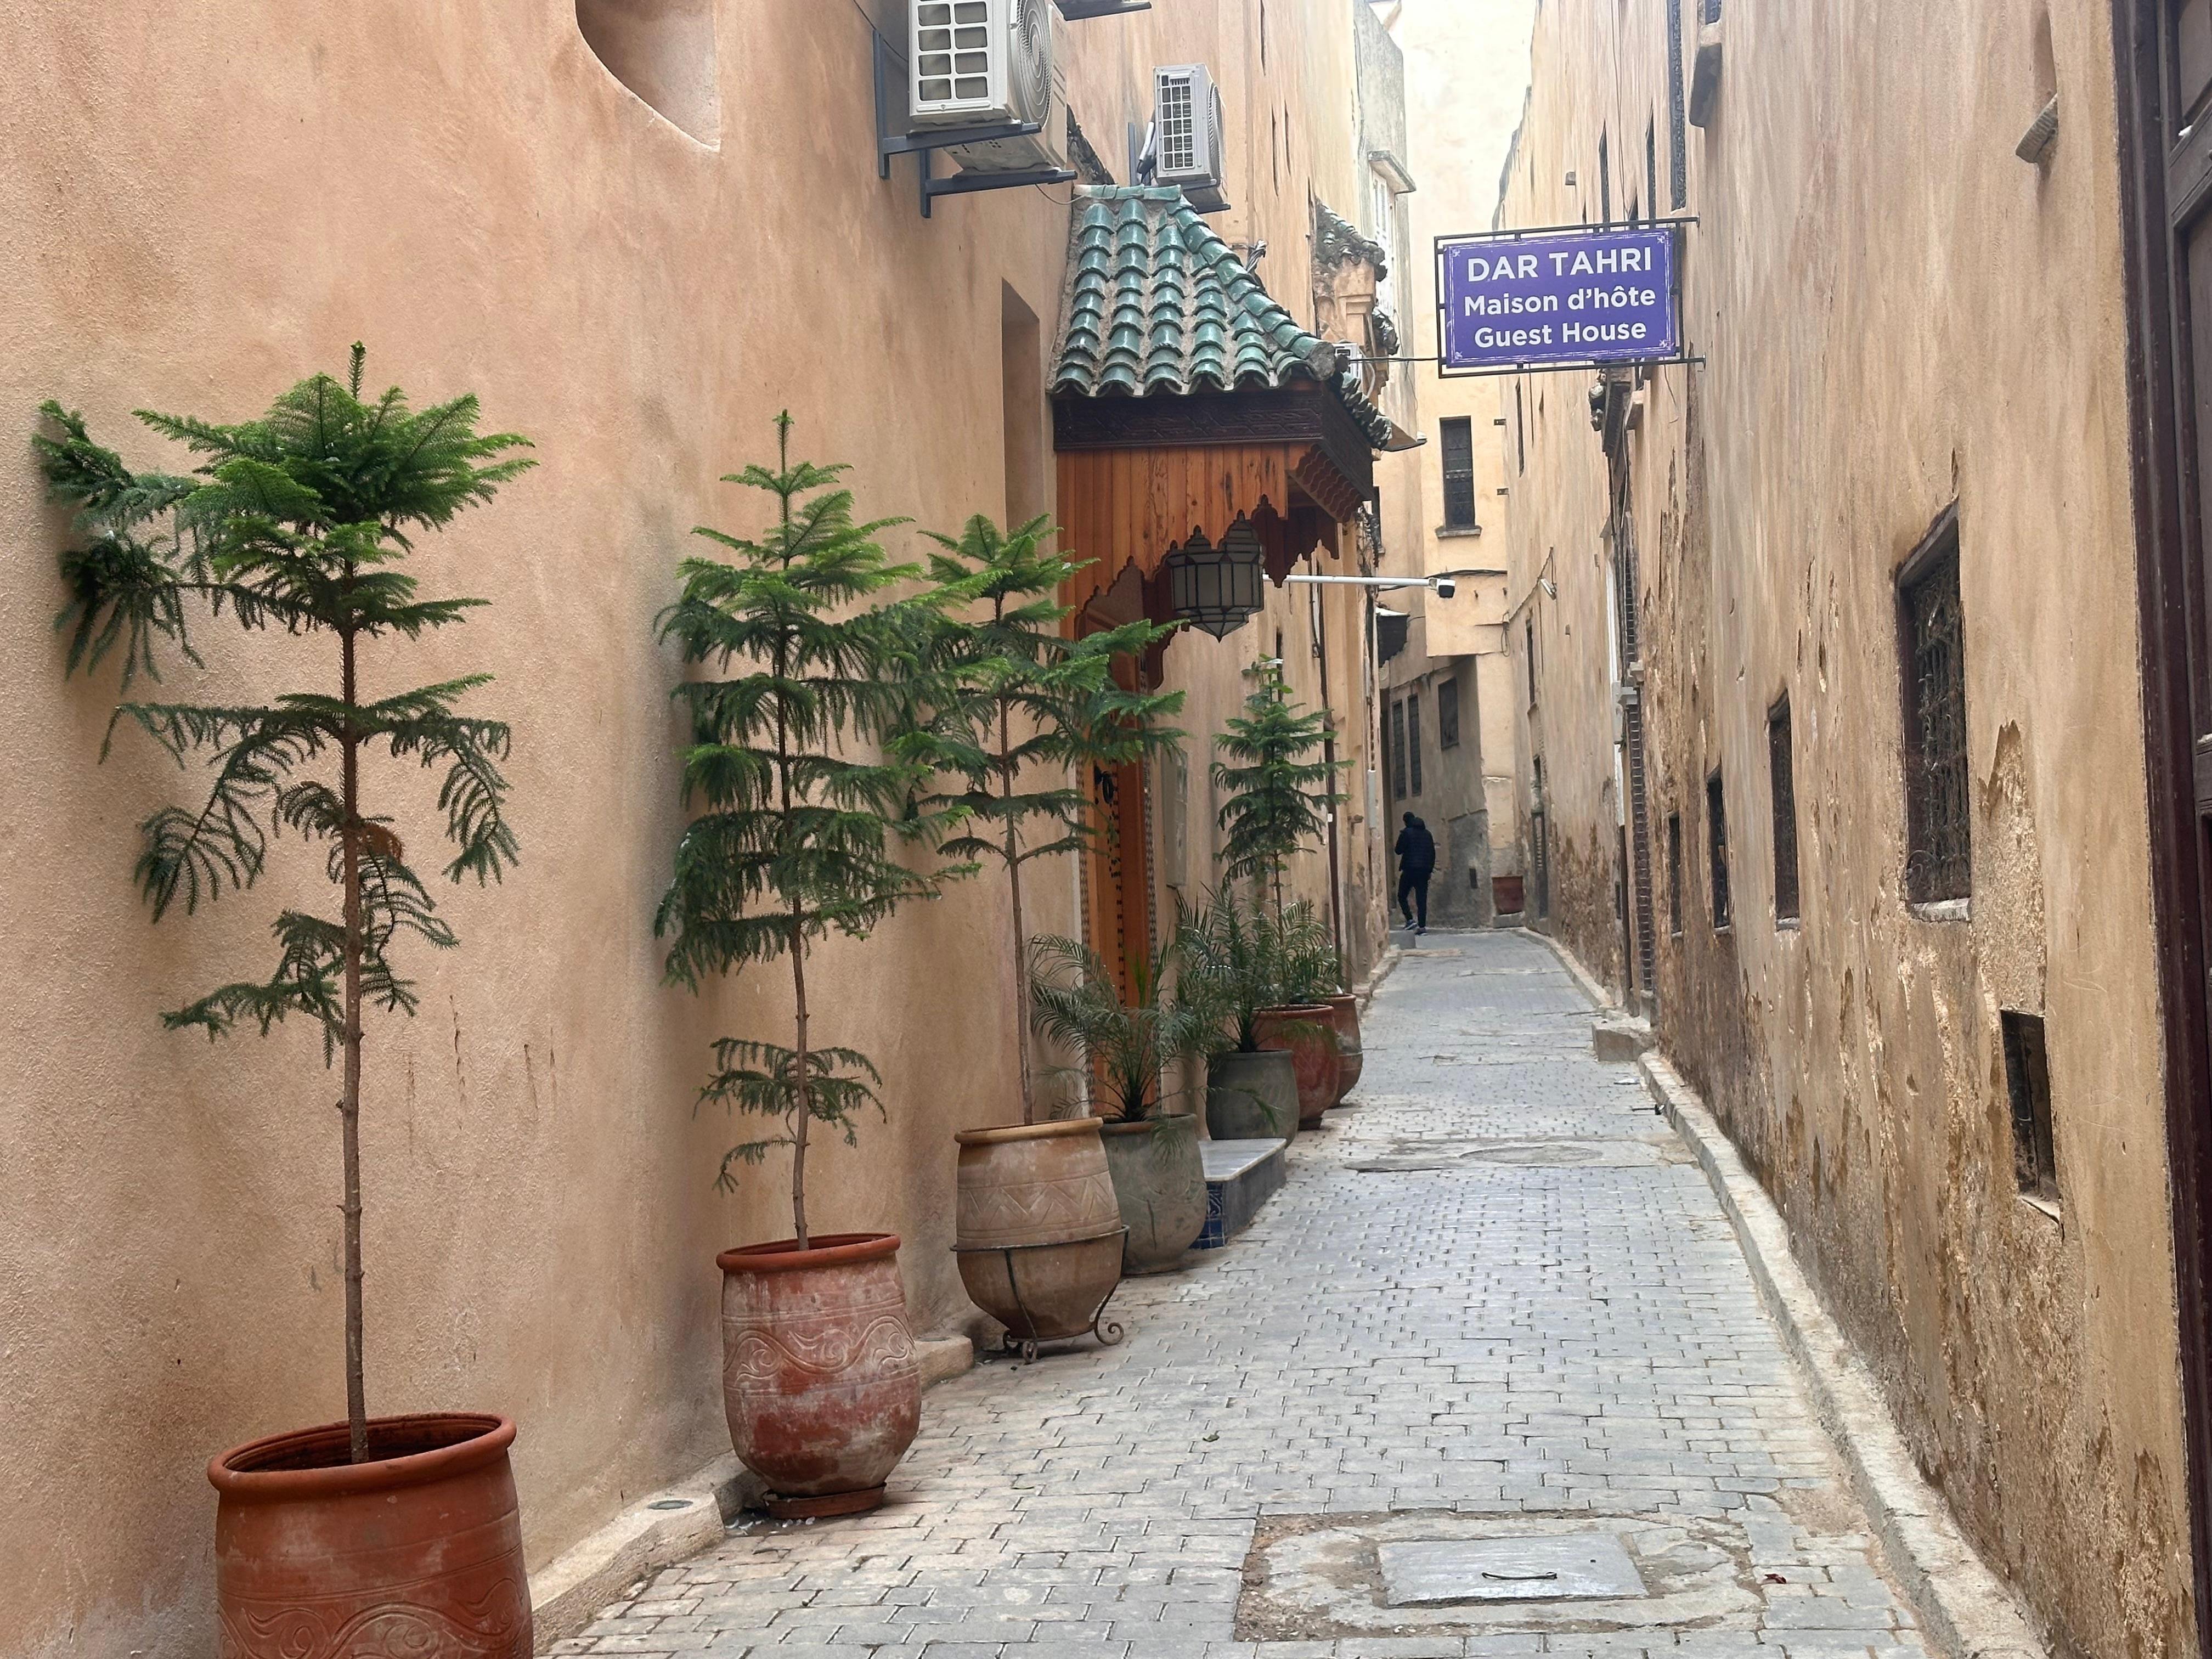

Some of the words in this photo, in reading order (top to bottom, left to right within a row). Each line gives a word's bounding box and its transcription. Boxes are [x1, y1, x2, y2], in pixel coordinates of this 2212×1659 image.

[1468, 254, 1538, 283] DAR
[1548, 246, 1652, 277] TAHRI
[1464, 292, 1559, 317] Maison
[1567, 285, 1656, 311] d’hôte
[1474, 324, 1553, 348] Guest
[1562, 321, 1647, 344] House
